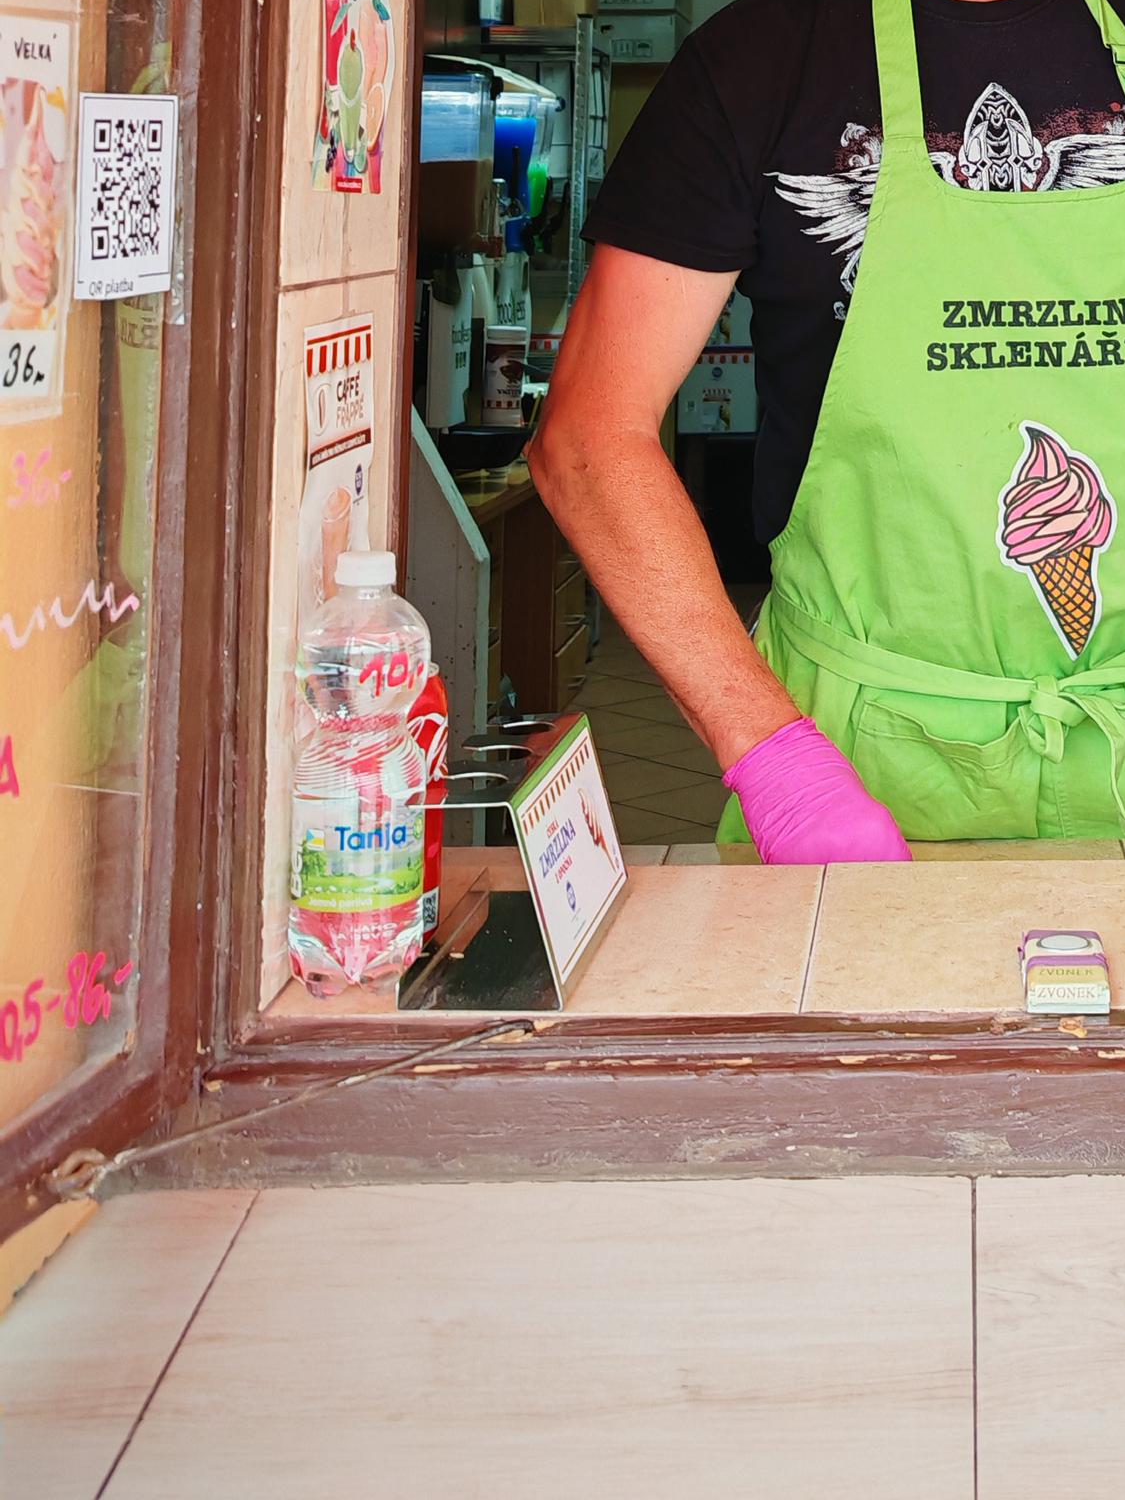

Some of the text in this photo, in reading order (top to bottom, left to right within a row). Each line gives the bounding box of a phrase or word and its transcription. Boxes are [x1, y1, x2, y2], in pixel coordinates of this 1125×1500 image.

[14, 32, 57, 63] VELKÁ
[336, 370, 362, 403] CAFFÉ
[334, 822, 407, 852] Tanja
[539, 817, 577, 879] ZMRZLINA
[1037, 986, 1096, 999] ZVONEK
